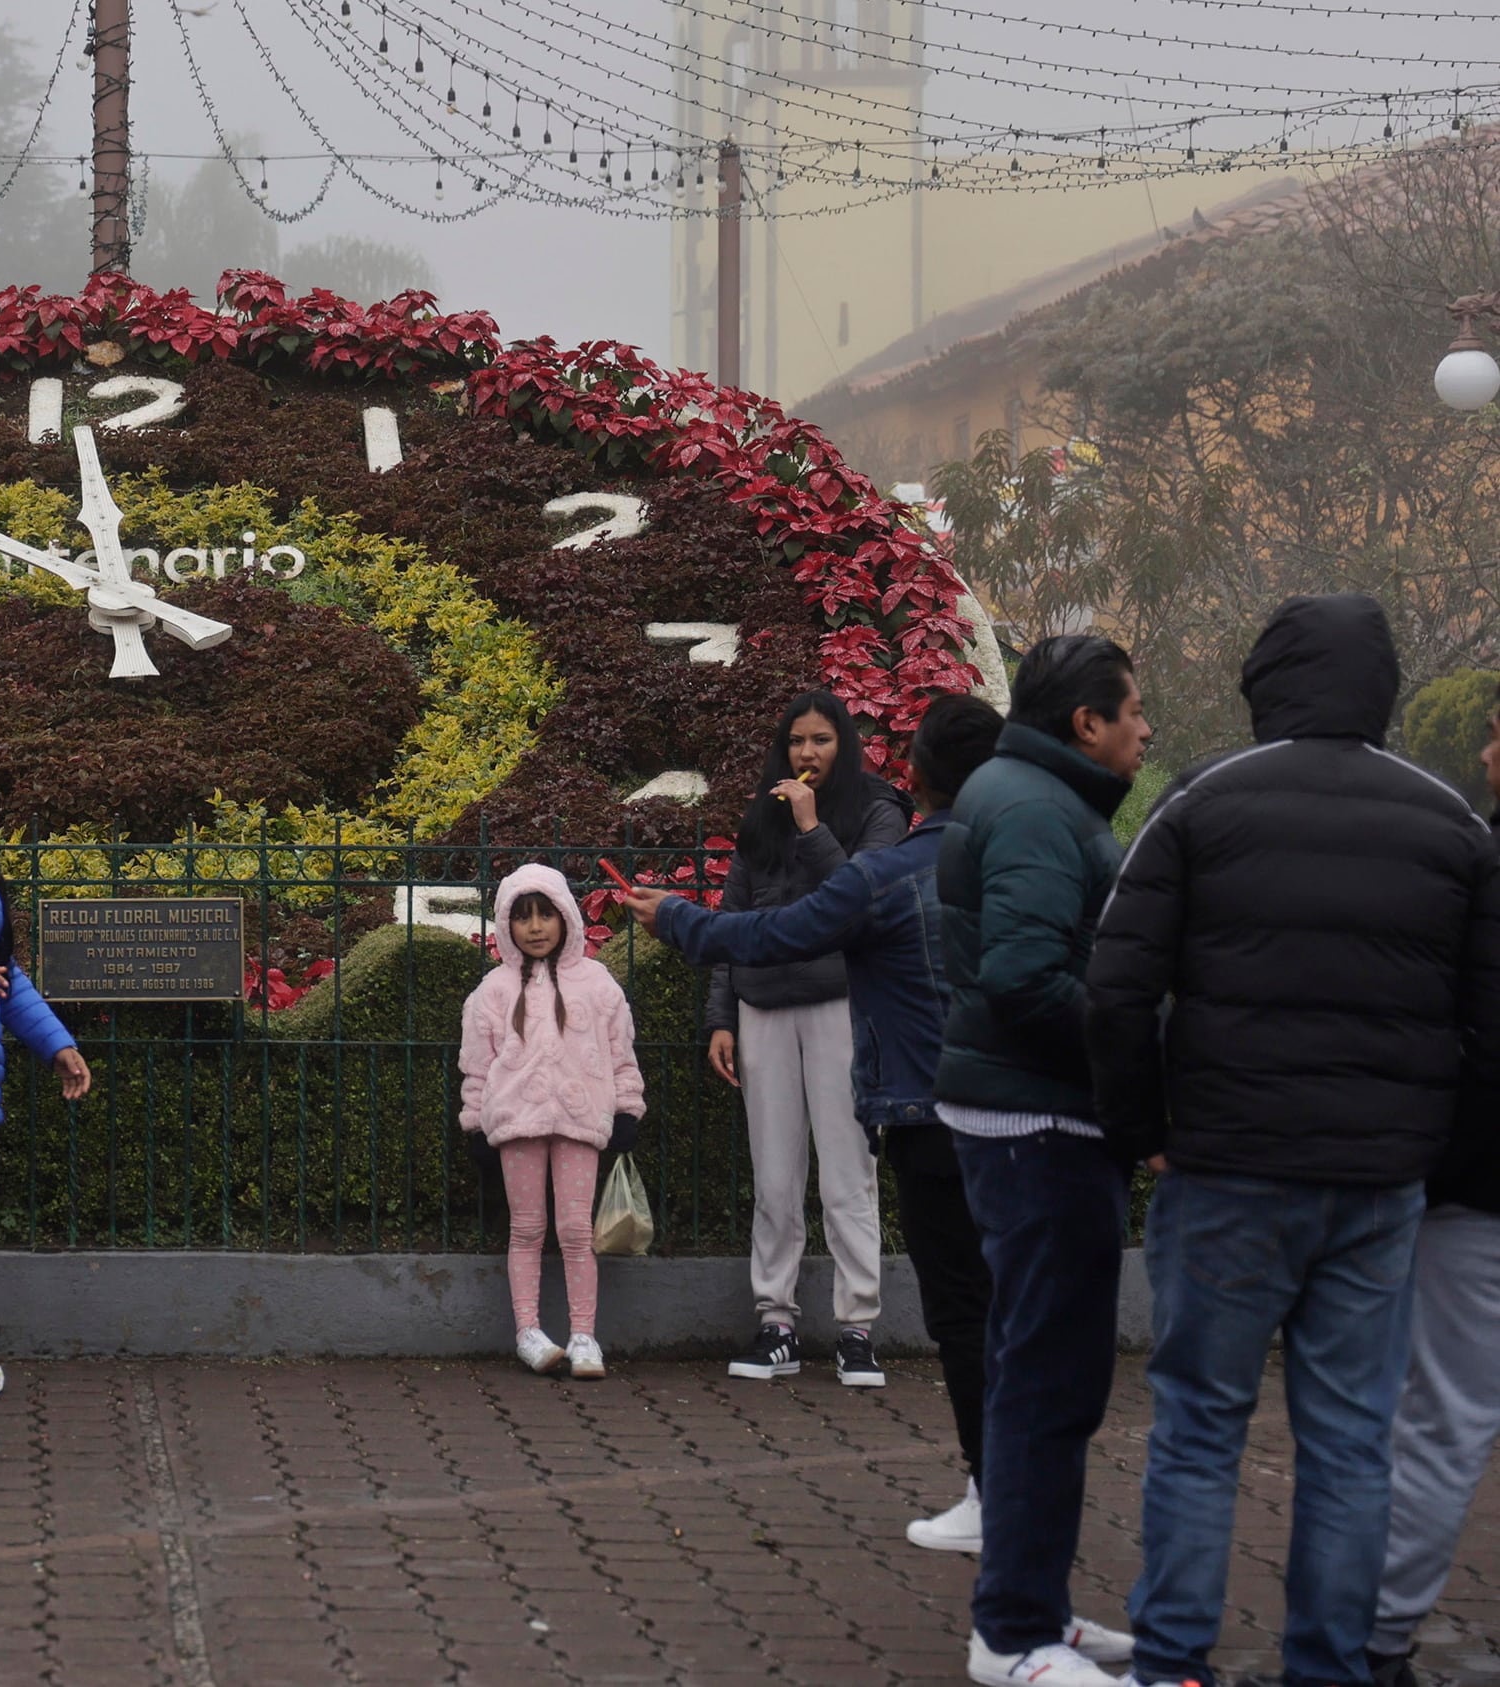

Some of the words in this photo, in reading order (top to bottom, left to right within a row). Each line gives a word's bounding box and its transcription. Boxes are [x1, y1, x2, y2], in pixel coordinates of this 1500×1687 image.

[28, 375, 187, 444] 12
[363, 405, 403, 473] 1
[543, 491, 651, 552] 2
[49, 909, 99, 925] RELOJ
[104, 909, 163, 925] FLORAL
[168, 908, 233, 924] MUSICAL
[44, 929, 75, 943] DONADO
[77, 929, 94, 943] POR
[212, 928, 222, 942] DE
[86, 946, 197, 959] AYUNTAMIENTO
[102, 963, 134, 974] 1984
[151, 962, 181, 974] 1987
[119, 979, 140, 990] PUE.
[142, 978, 176, 990] AGOSTO
[179, 978, 190, 990] DE
